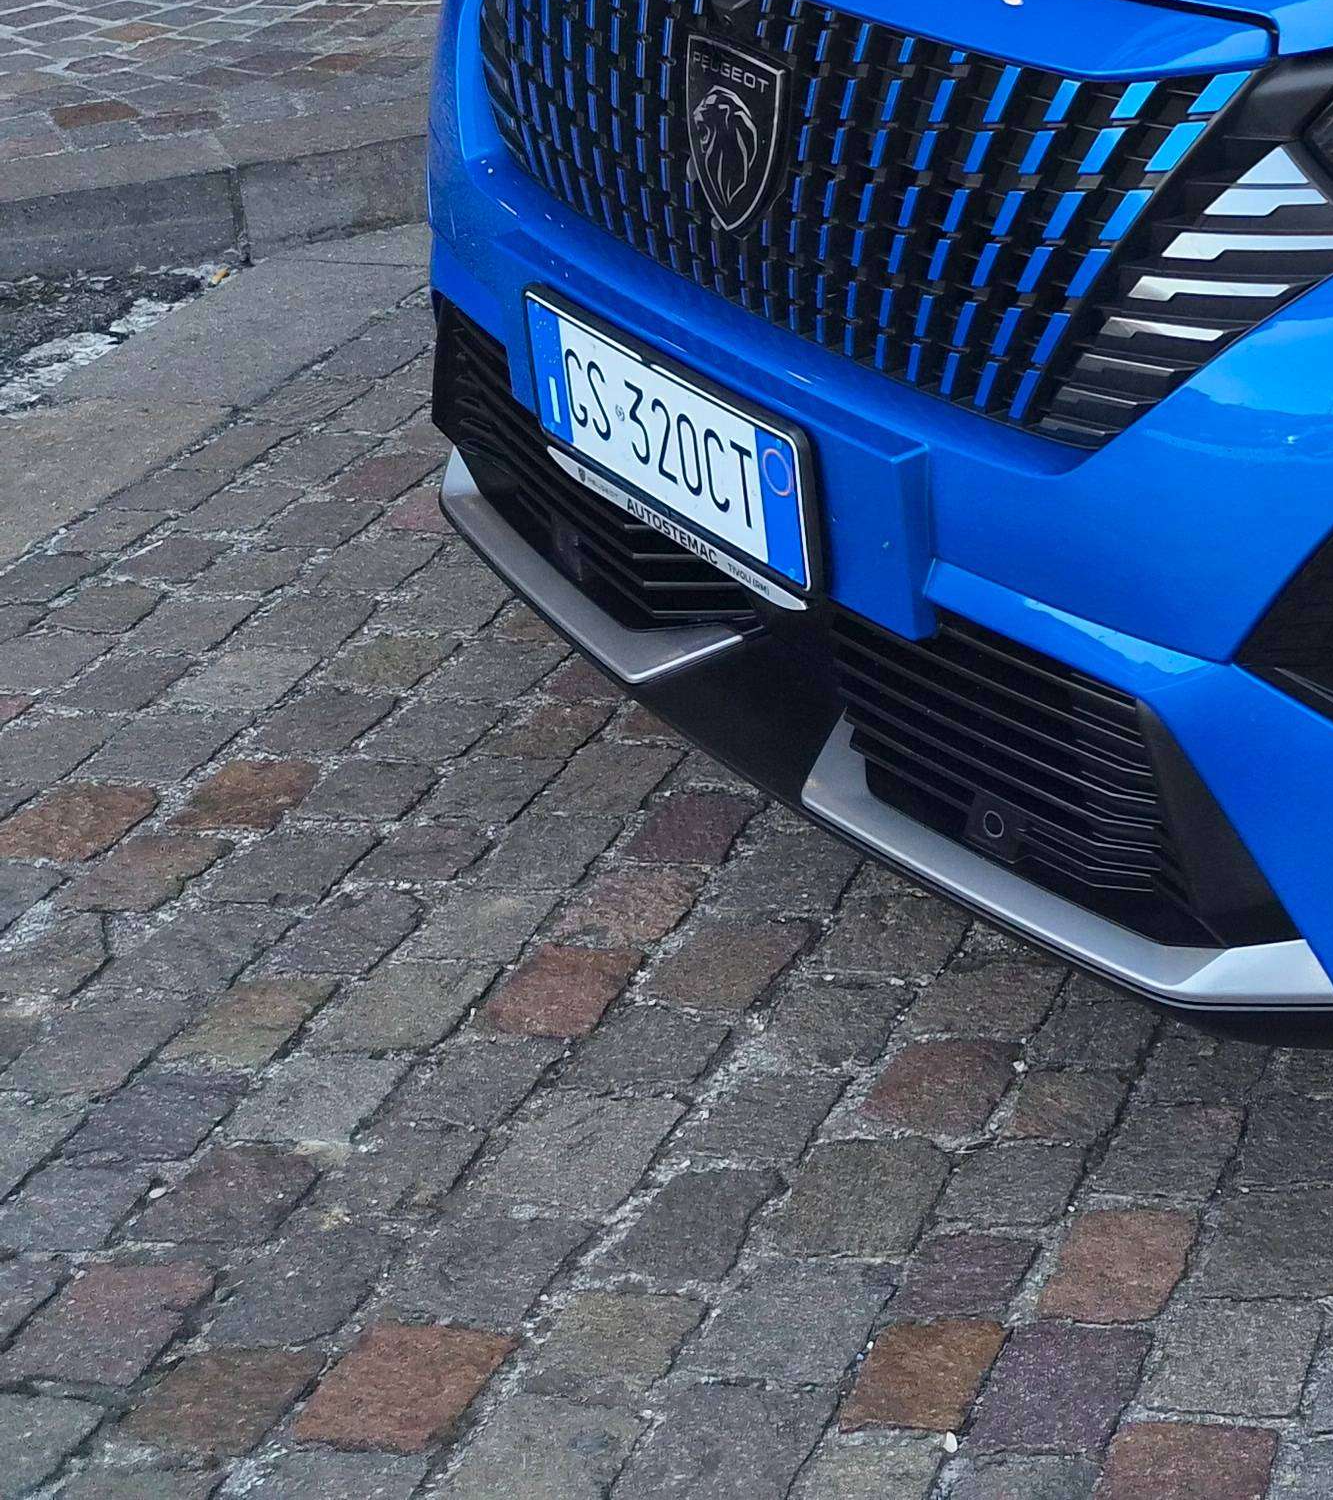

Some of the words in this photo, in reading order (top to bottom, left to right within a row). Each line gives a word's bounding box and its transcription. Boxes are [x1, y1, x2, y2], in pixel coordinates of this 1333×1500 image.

[693, 51, 771, 95] PEUGEOT
[565, 348, 611, 442] GS
[624, 380, 753, 529] 320CT
[627, 497, 719, 566] AUTOSTEMAC
[727, 562, 751, 584] TIVOLI
[752, 578, 770, 597] (RM)
